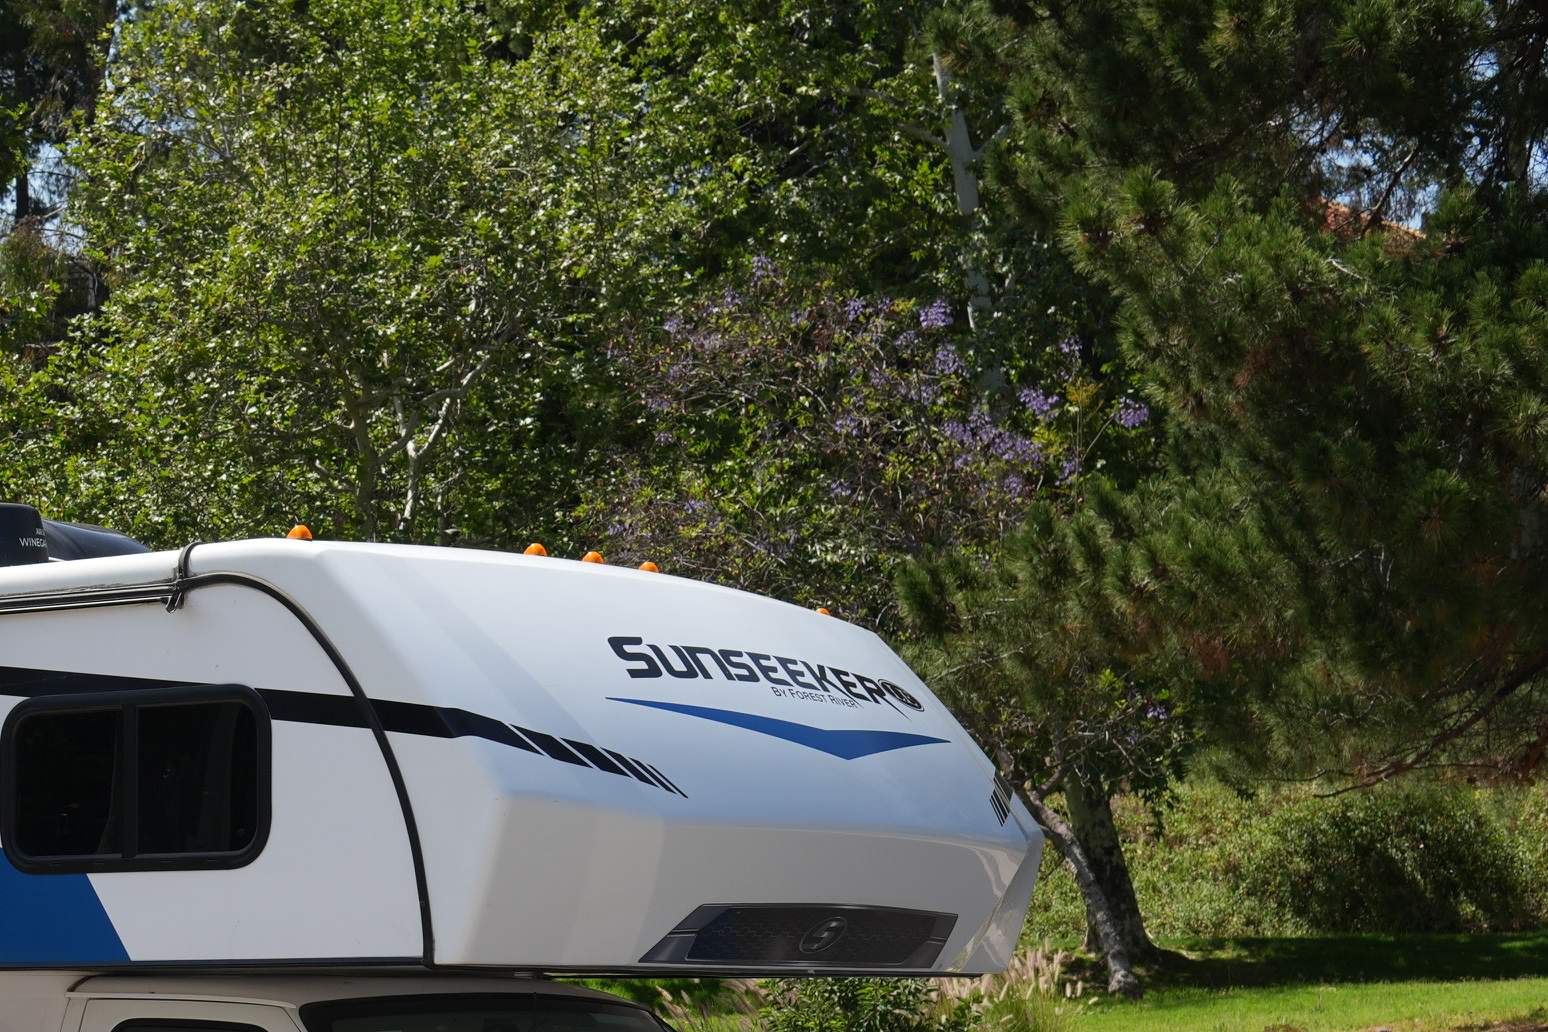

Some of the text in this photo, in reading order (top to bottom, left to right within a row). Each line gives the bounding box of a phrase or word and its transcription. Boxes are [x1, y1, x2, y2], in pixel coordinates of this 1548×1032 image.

[607, 636, 911, 722] SUNSEEKER
[789, 688, 830, 703] FOREST
[829, 694, 859, 709] RIVER
